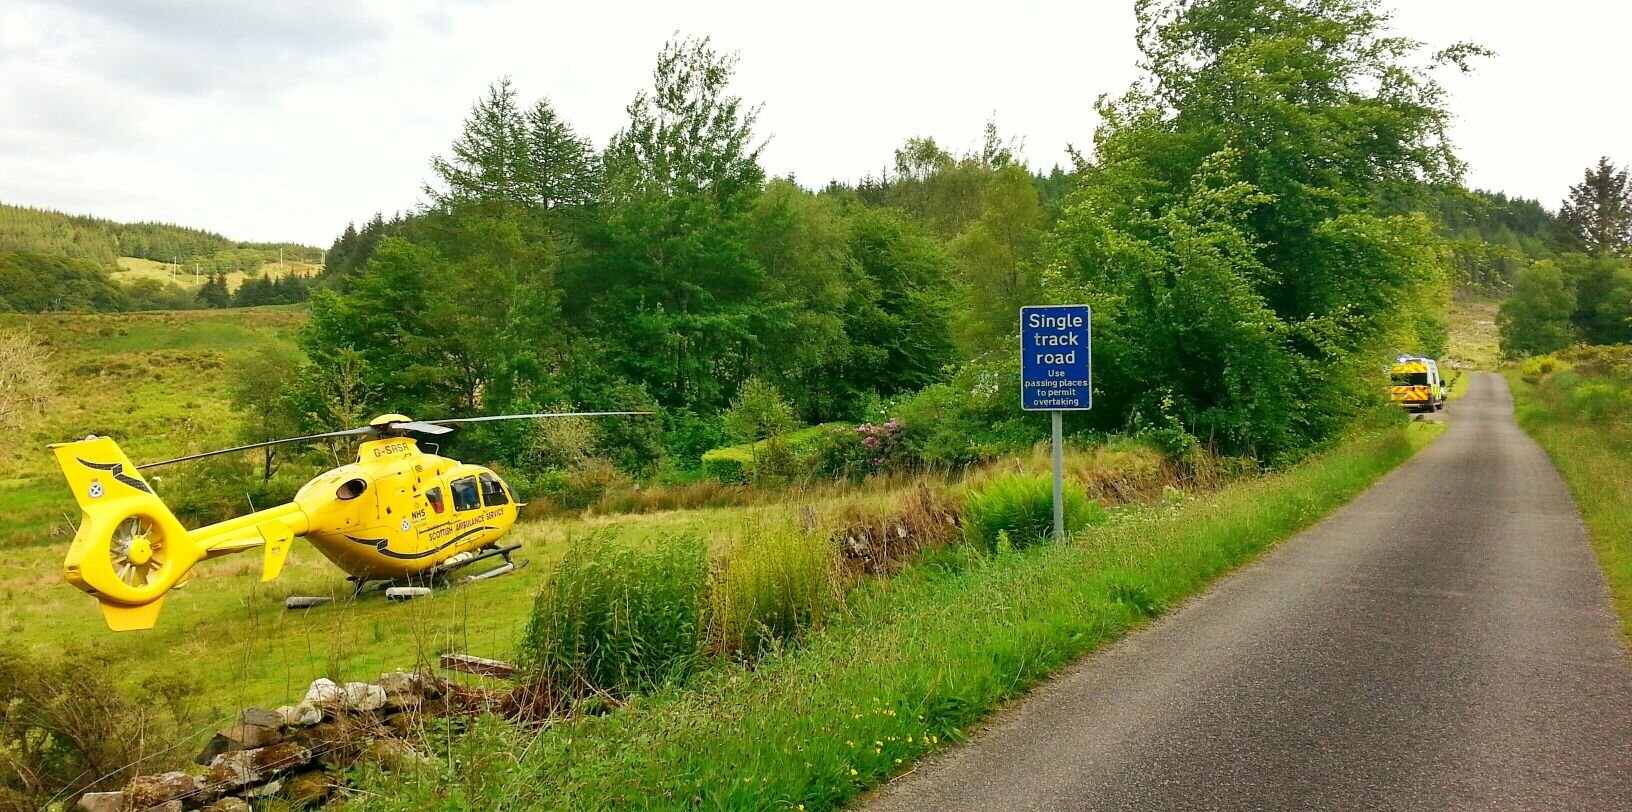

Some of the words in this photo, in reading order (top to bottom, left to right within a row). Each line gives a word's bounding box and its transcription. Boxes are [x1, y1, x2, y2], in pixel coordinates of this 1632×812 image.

[1029, 313, 1083, 331] Single
[1034, 331, 1079, 346] track
[1036, 350, 1076, 365] road
[1047, 369, 1065, 377] Use
[1025, 379, 1058, 388] passing
[1059, 379, 1088, 388] places
[1048, 388, 1076, 397] permit
[1033, 398, 1079, 407] overtaking
[411, 508, 426, 520] NHS
[429, 525, 453, 541] SCOTTISH
[456, 514, 485, 532] AMBULANCE
[486, 507, 504, 520] SERVICE
